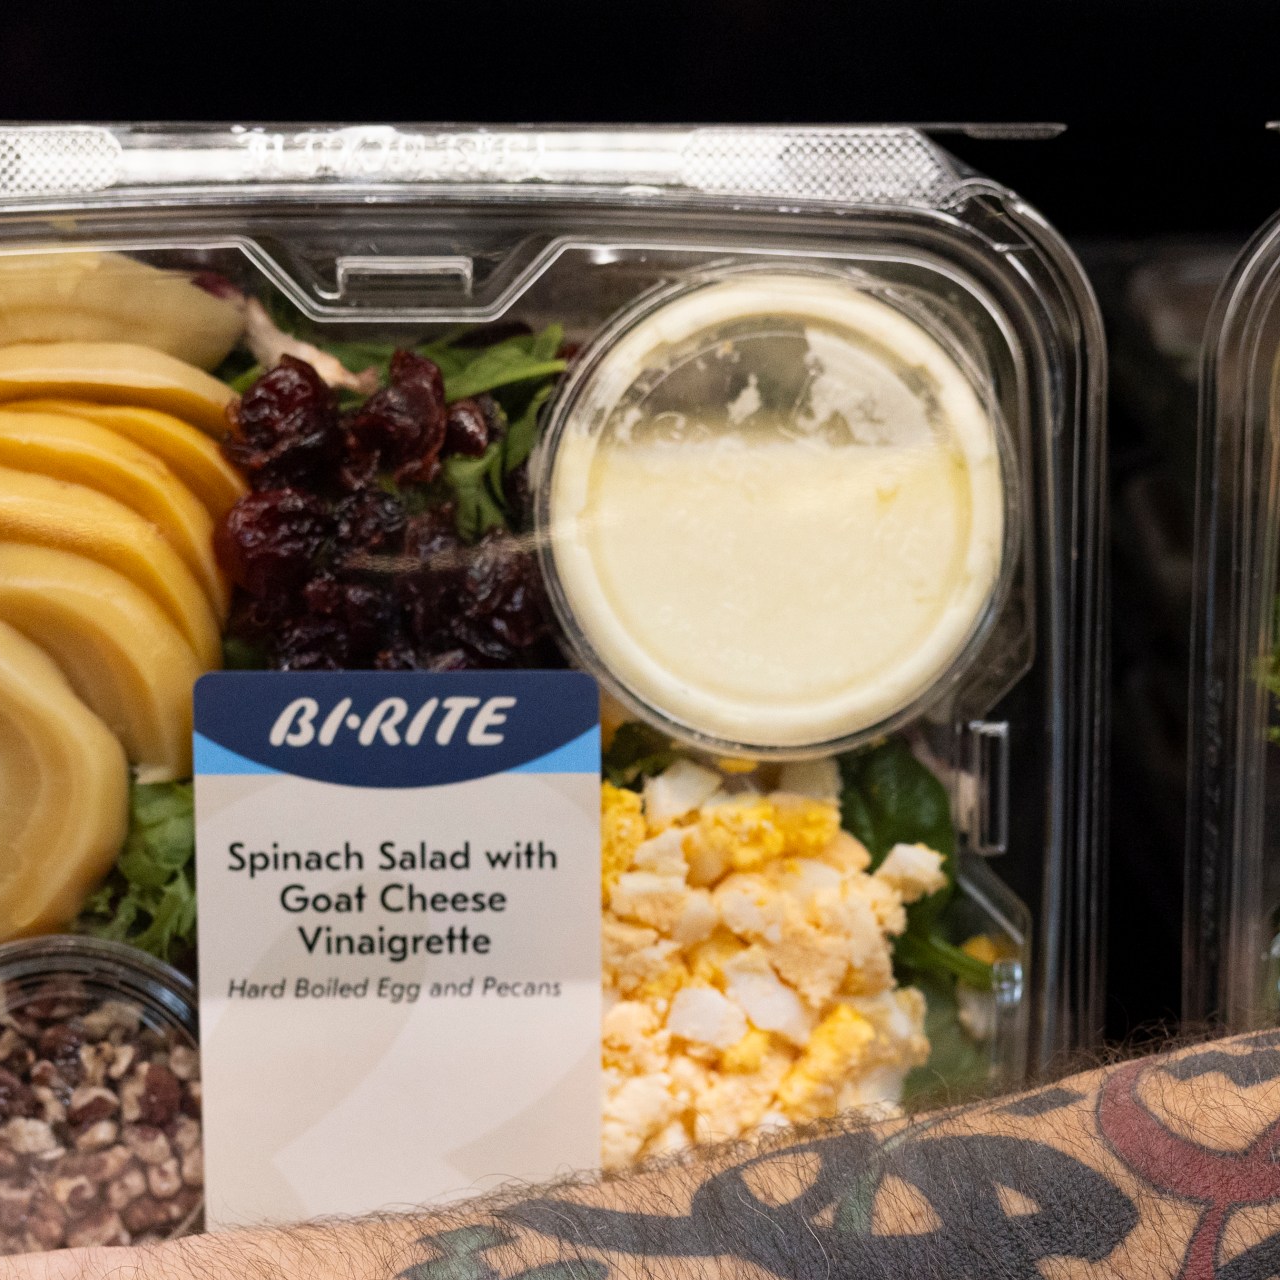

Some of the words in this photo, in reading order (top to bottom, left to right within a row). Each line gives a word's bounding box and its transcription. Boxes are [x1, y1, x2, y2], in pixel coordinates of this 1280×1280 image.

[227, 841, 365, 877] Spinach
[378, 841, 471, 870] Salad
[486, 841, 558, 870] with
[280, 883, 367, 913] Goat
[380, 883, 508, 913] Cheese
[298, 926, 492, 963] Vinaigrette
[228, 978, 286, 999] Hard
[295, 977, 370, 999] Boiled
[377, 978, 420, 1003] Egg
[430, 977, 473, 998] and
[482, 977, 562, 998] Pecans
